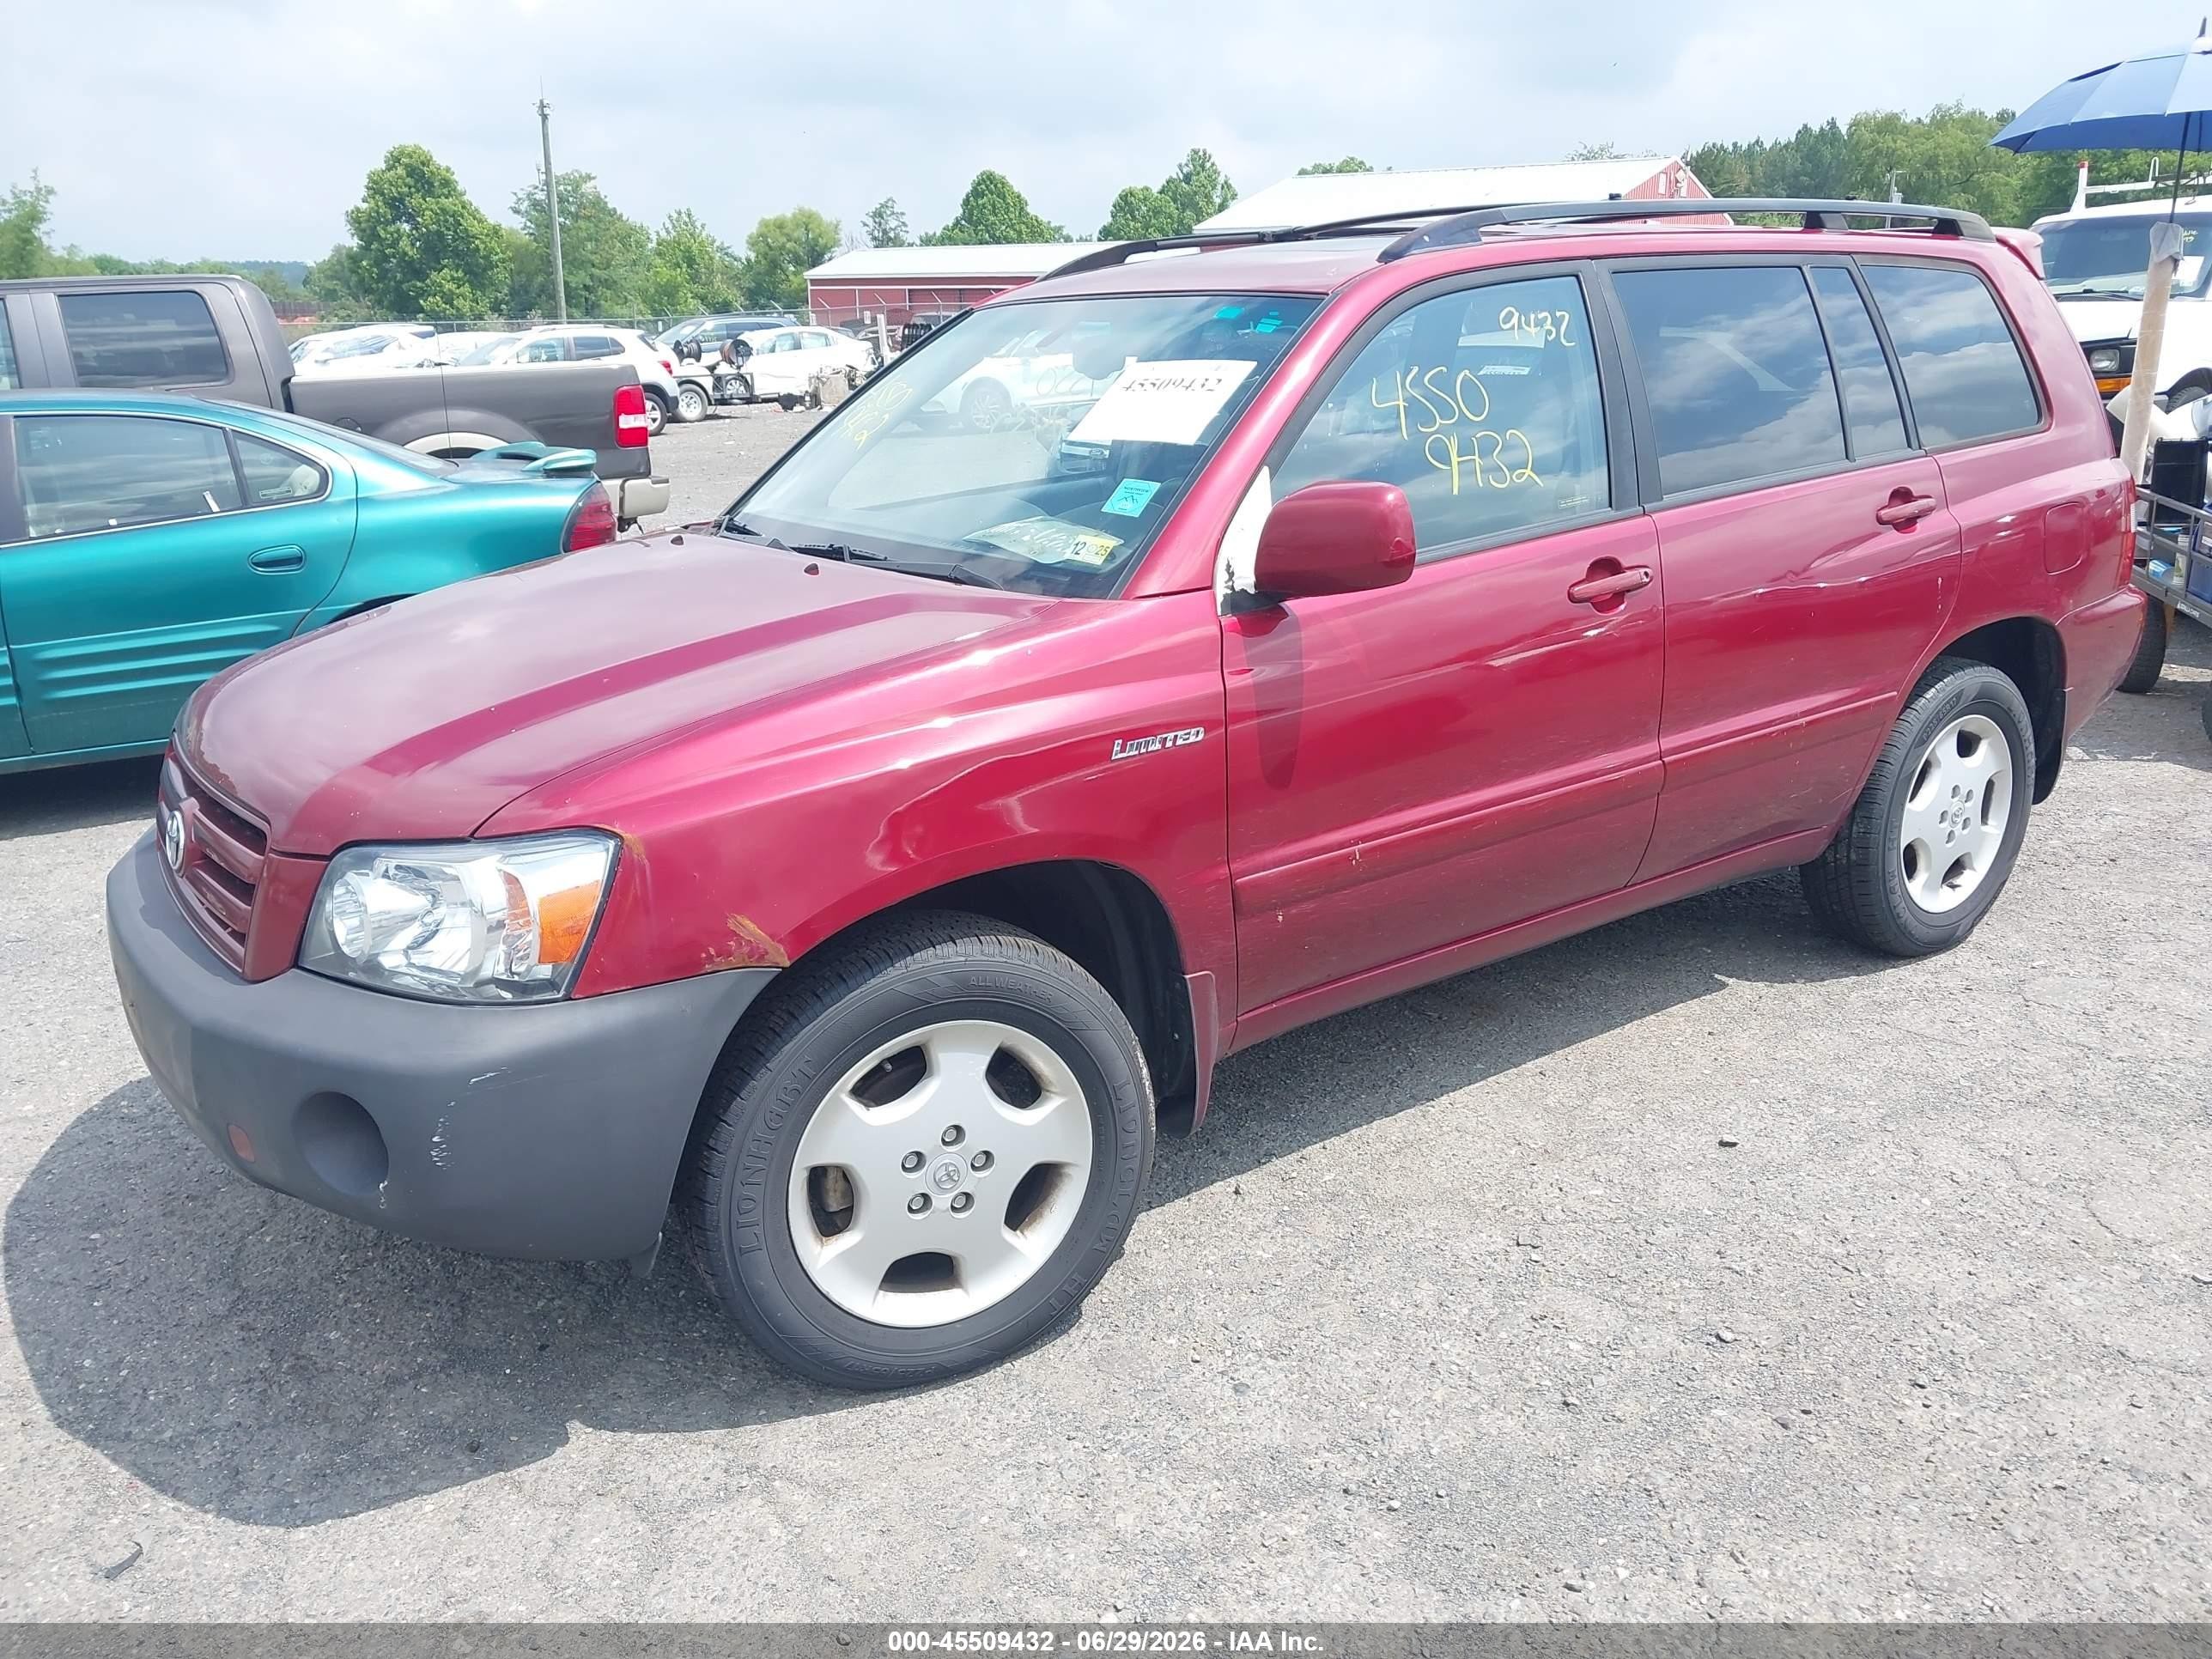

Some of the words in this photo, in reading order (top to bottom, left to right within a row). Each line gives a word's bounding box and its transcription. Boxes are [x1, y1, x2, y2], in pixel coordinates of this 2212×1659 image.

[1499, 307, 1577, 346] 9432
[1371, 366, 1490, 441] 4550
[1425, 429, 1544, 495] 9432
[1071, 541, 1086, 556] 12
[1095, 544, 1110, 556] 25
[1111, 726, 1205, 760] LIMITED
[969, 975, 992, 988] ALL
[994, 976, 1054, 1003] WEATHER
[1048, 1272, 1087, 1317] HT
